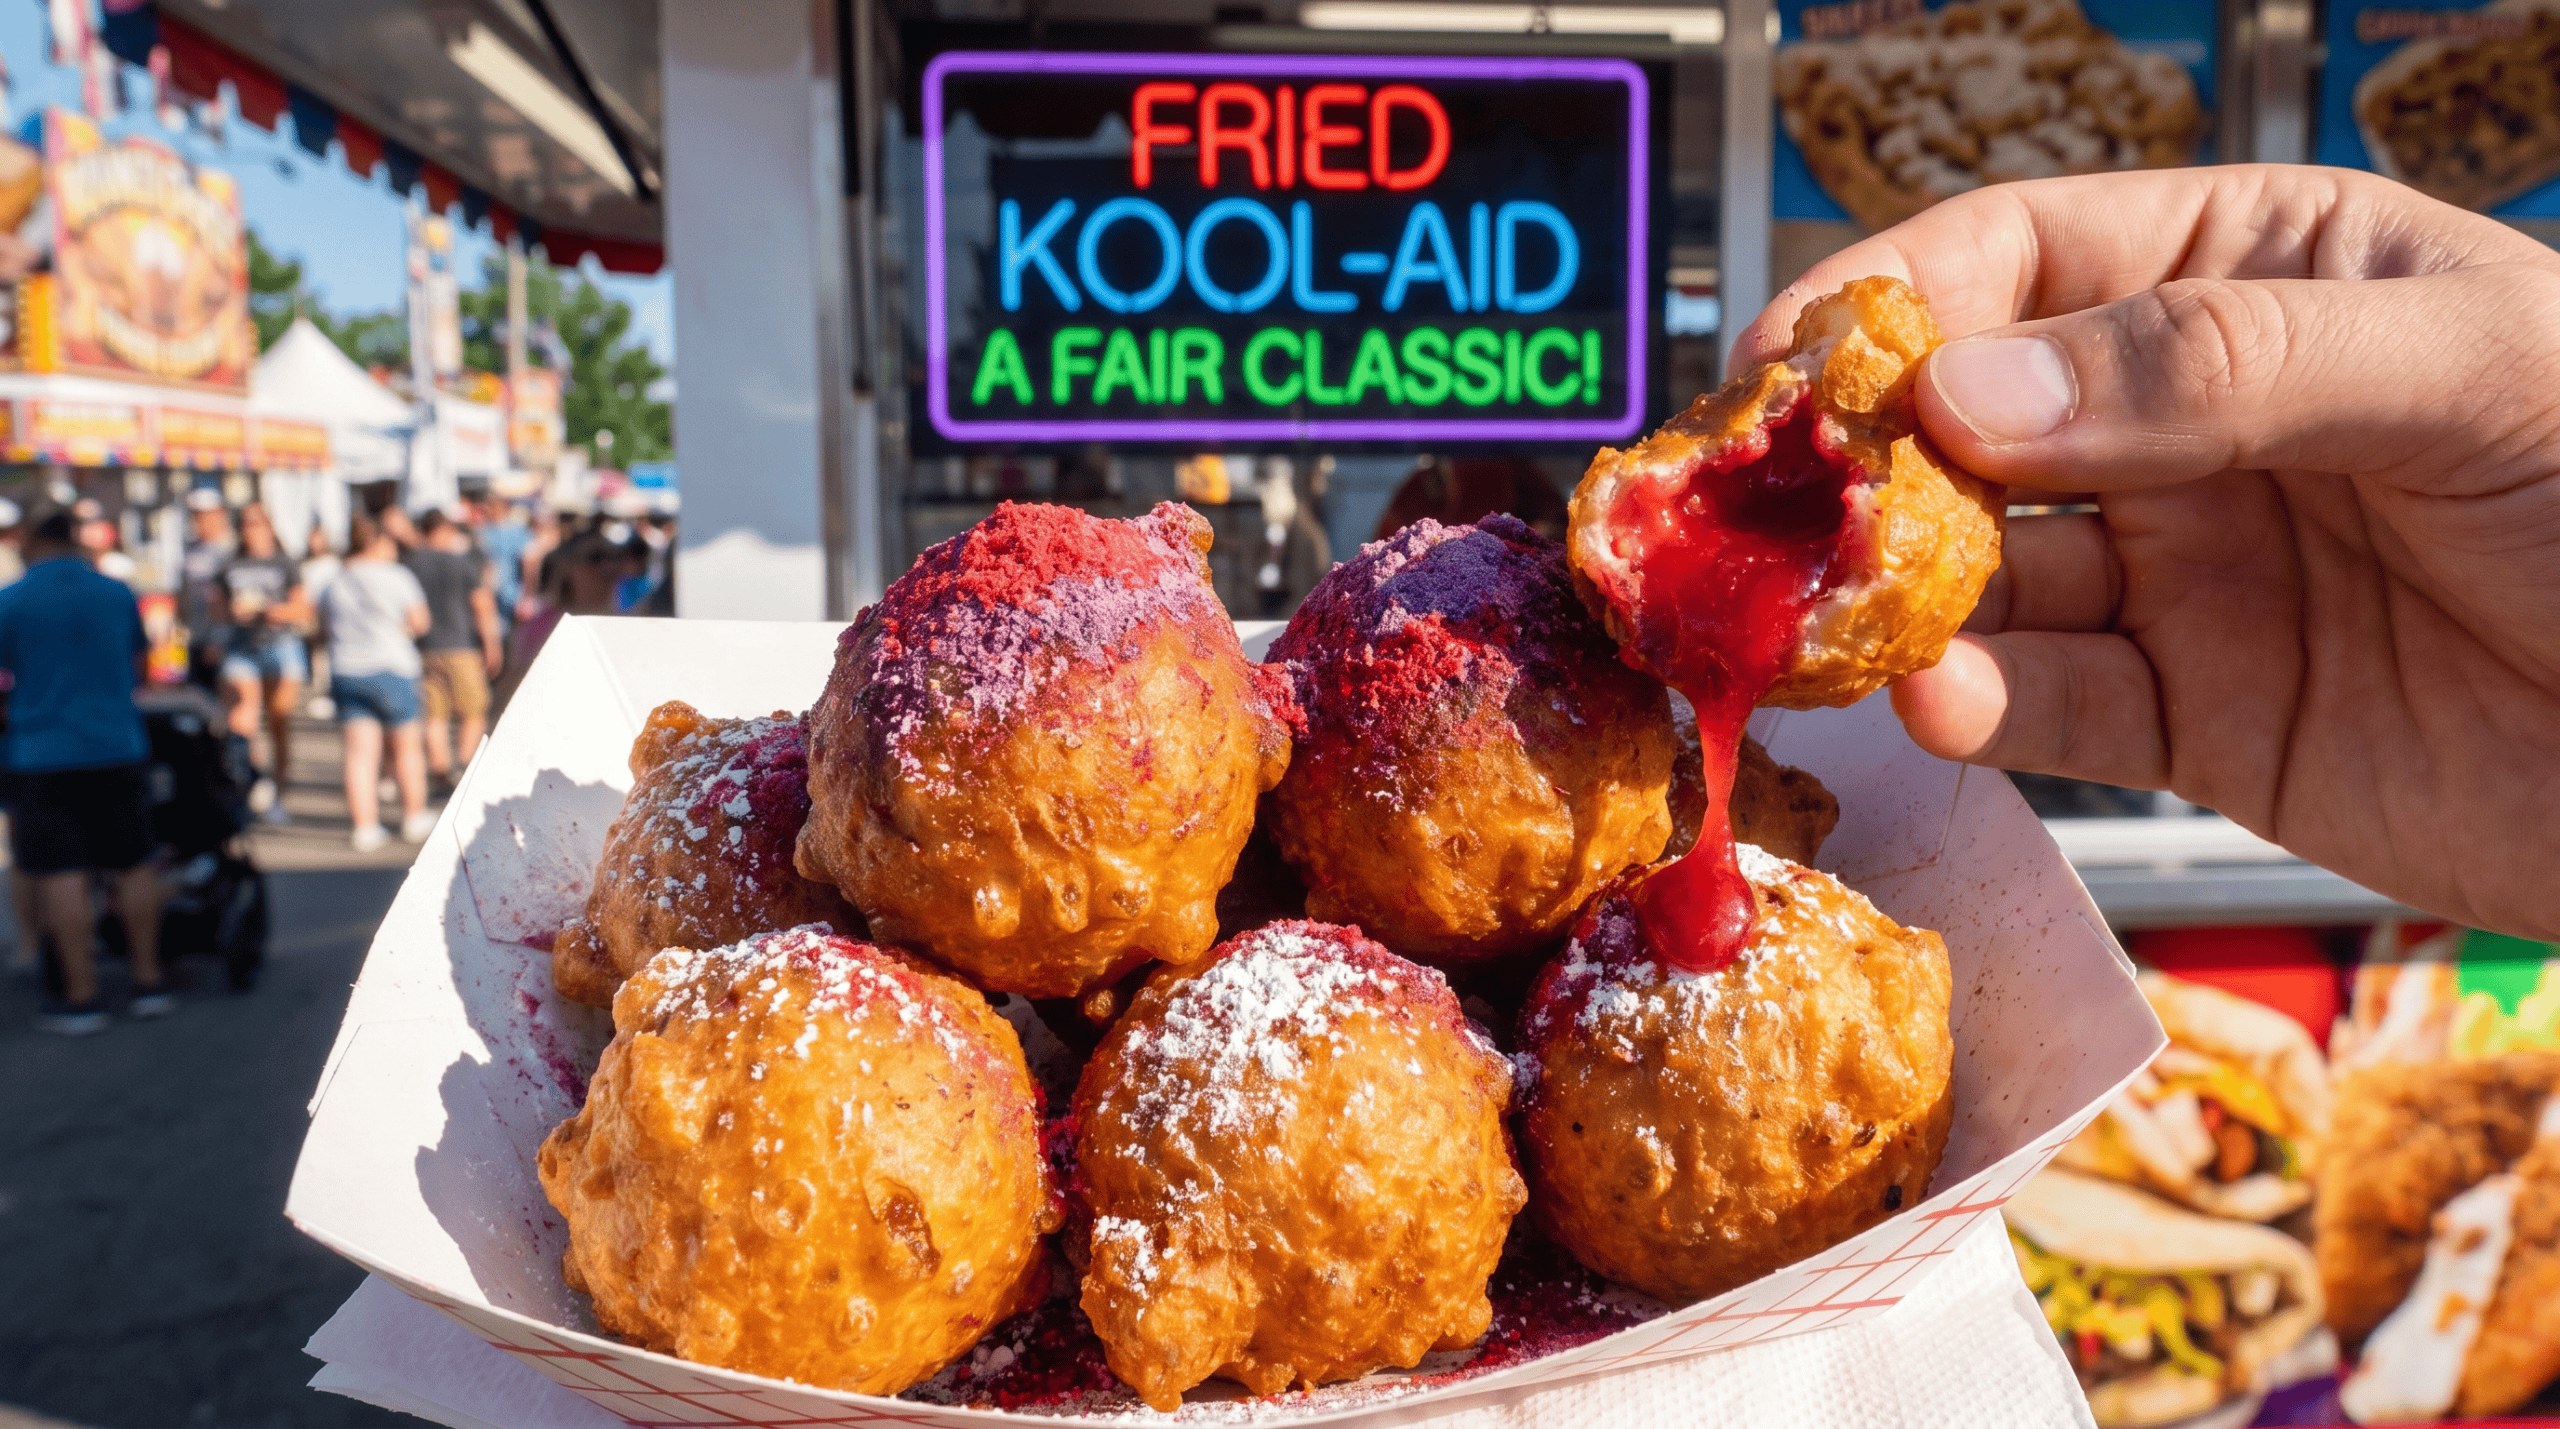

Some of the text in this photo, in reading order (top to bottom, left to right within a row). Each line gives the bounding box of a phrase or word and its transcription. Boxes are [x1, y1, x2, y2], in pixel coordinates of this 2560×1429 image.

[1131, 82, 1452, 191] FRIED
[1000, 198, 1580, 313] KOOL-AID
[971, 326, 1602, 406] A FAIR CLASSIC!
